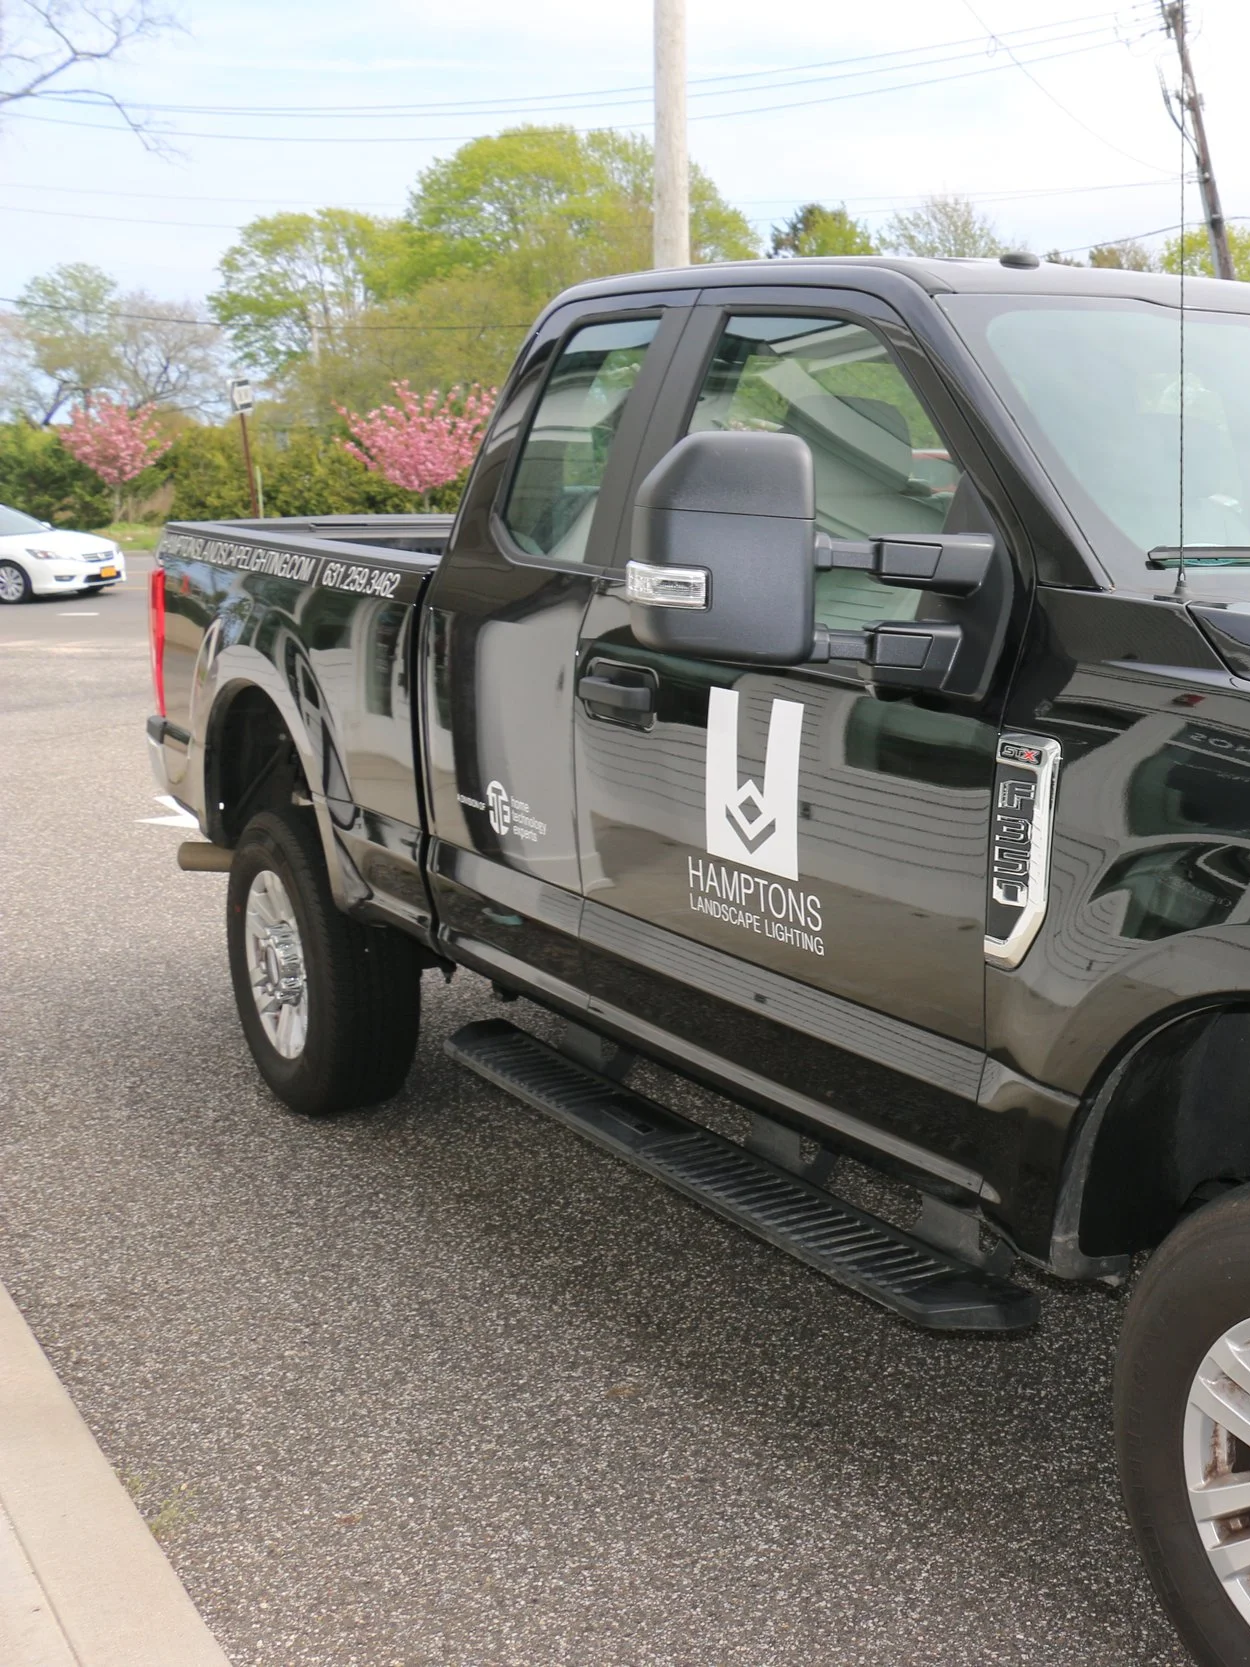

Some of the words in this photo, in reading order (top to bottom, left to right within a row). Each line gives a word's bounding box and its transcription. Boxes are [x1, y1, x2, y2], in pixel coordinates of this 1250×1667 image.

[322, 562, 401, 598] 631.259.3462
[1002, 745, 1041, 765] STX
[510, 796, 530, 813] home
[512, 810, 547, 836] technology
[513, 826, 538, 842] experts
[688, 856, 823, 932] HAMPTONS
[690, 892, 761, 933] LANDSCAPE
[766, 919, 824, 956] LIGHTING
